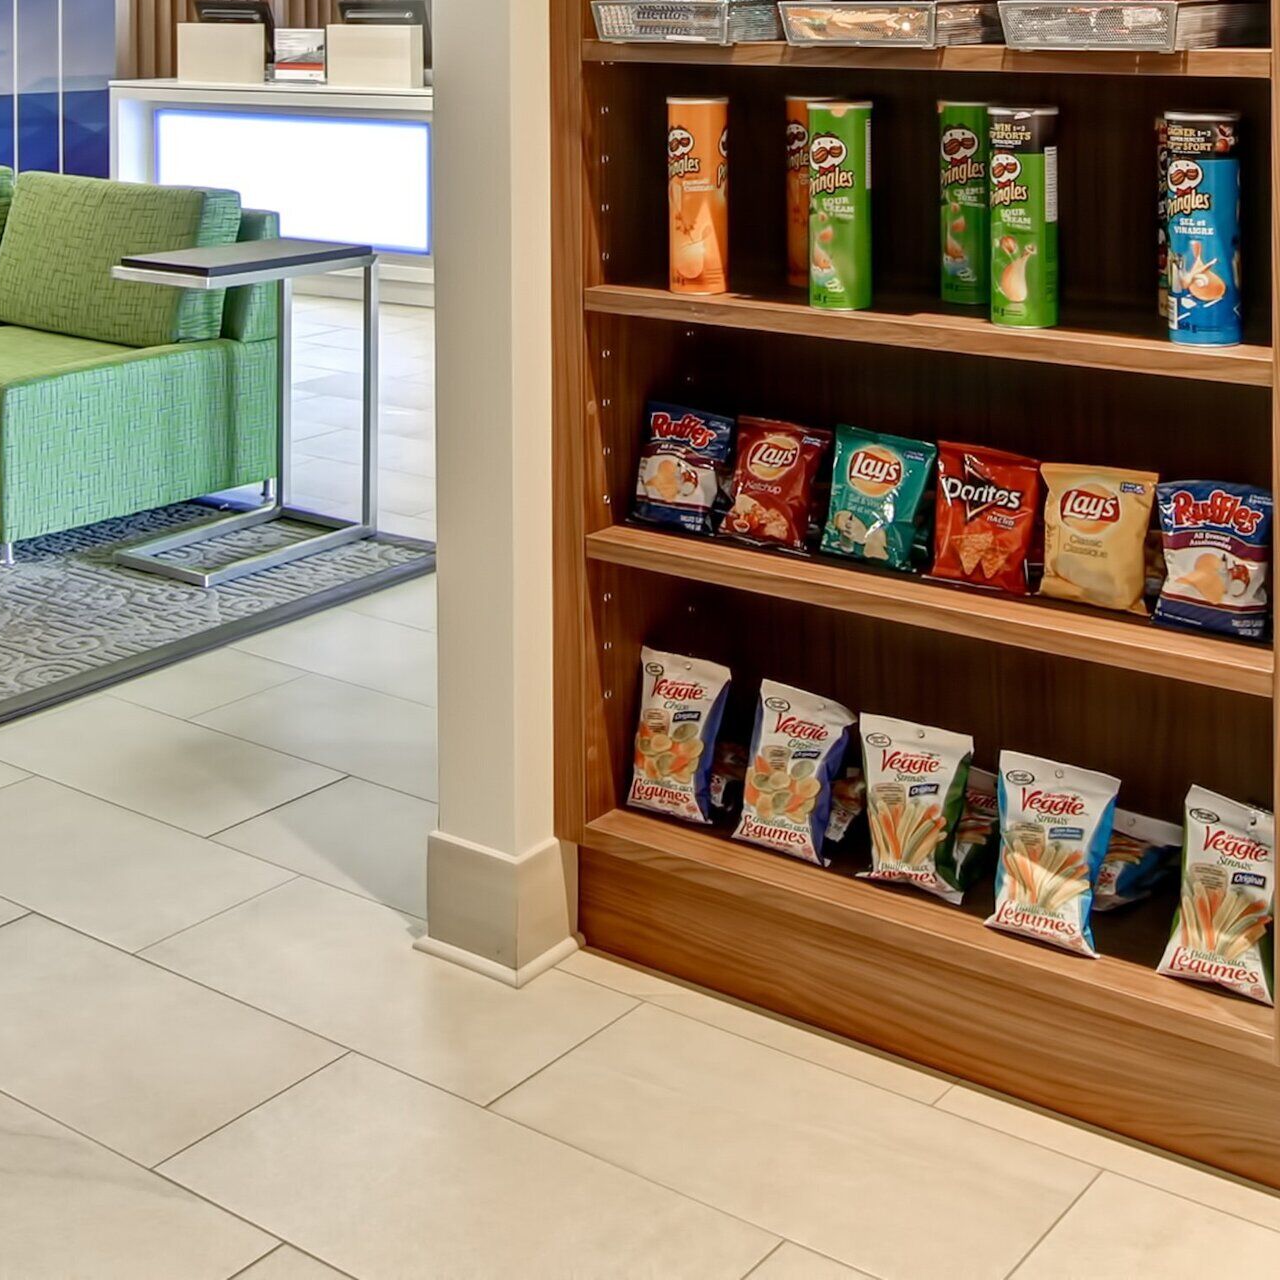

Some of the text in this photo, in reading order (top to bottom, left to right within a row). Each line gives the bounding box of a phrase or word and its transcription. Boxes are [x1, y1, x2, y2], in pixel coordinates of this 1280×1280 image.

[651, 412, 717, 449] Ruffles
[745, 480, 782, 495] Ketchup
[946, 476, 1021, 509] Doritos
[1171, 489, 1264, 536] Ruffles
[1063, 542, 1108, 559] Classique
[1070, 536, 1103, 548] Classic
[651, 676, 703, 701] Veggie
[775, 713, 829, 742] Veggie
[881, 749, 940, 774] Veggie
[1021, 787, 1085, 816] Veggie
[1203, 825, 1269, 863] Veggie
[1233, 874, 1265, 887] Original
